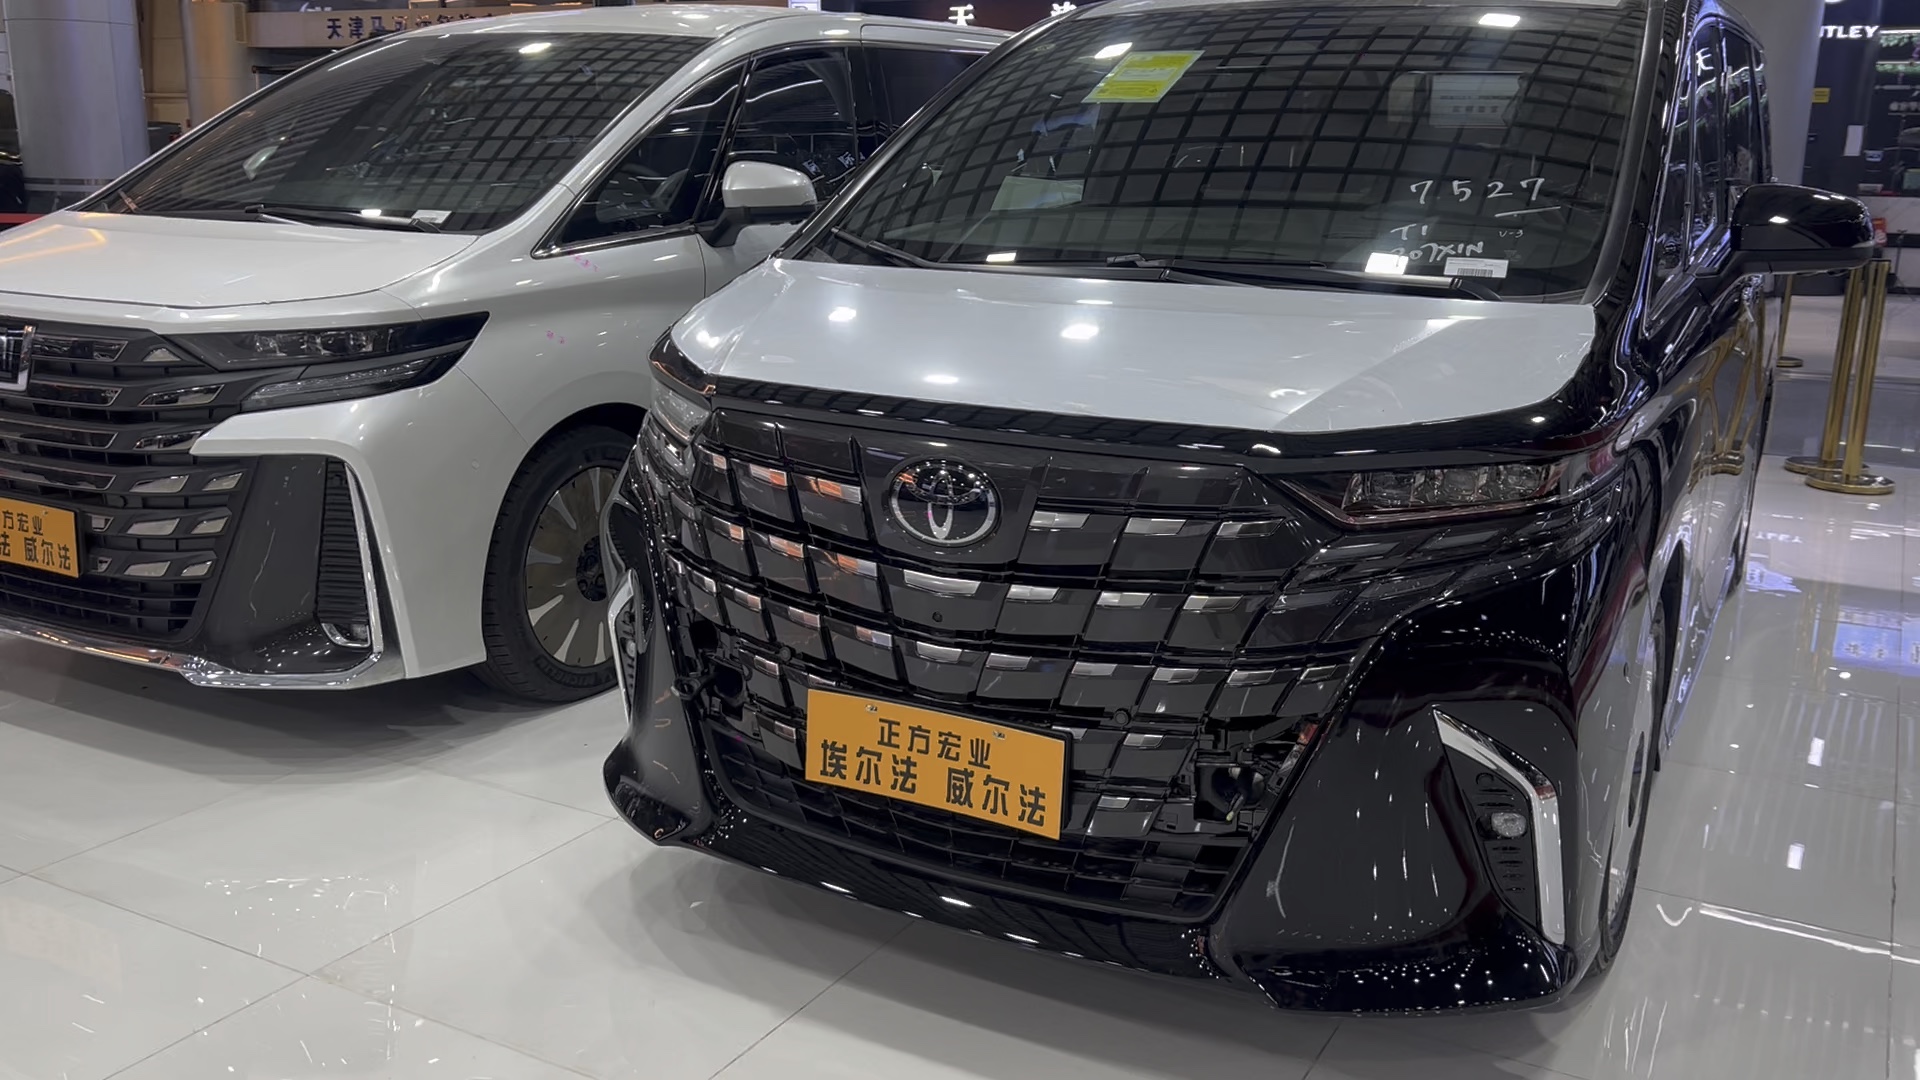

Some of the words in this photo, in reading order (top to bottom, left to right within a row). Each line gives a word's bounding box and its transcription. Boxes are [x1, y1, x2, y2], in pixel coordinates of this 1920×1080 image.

[1410, 178, 1545, 204] 7527
[24, 536, 71, 571] 威尔法
[877, 717, 991, 770] 正方宏业
[820, 738, 917, 794] 埃尔法
[946, 767, 1047, 827] 威尔法
